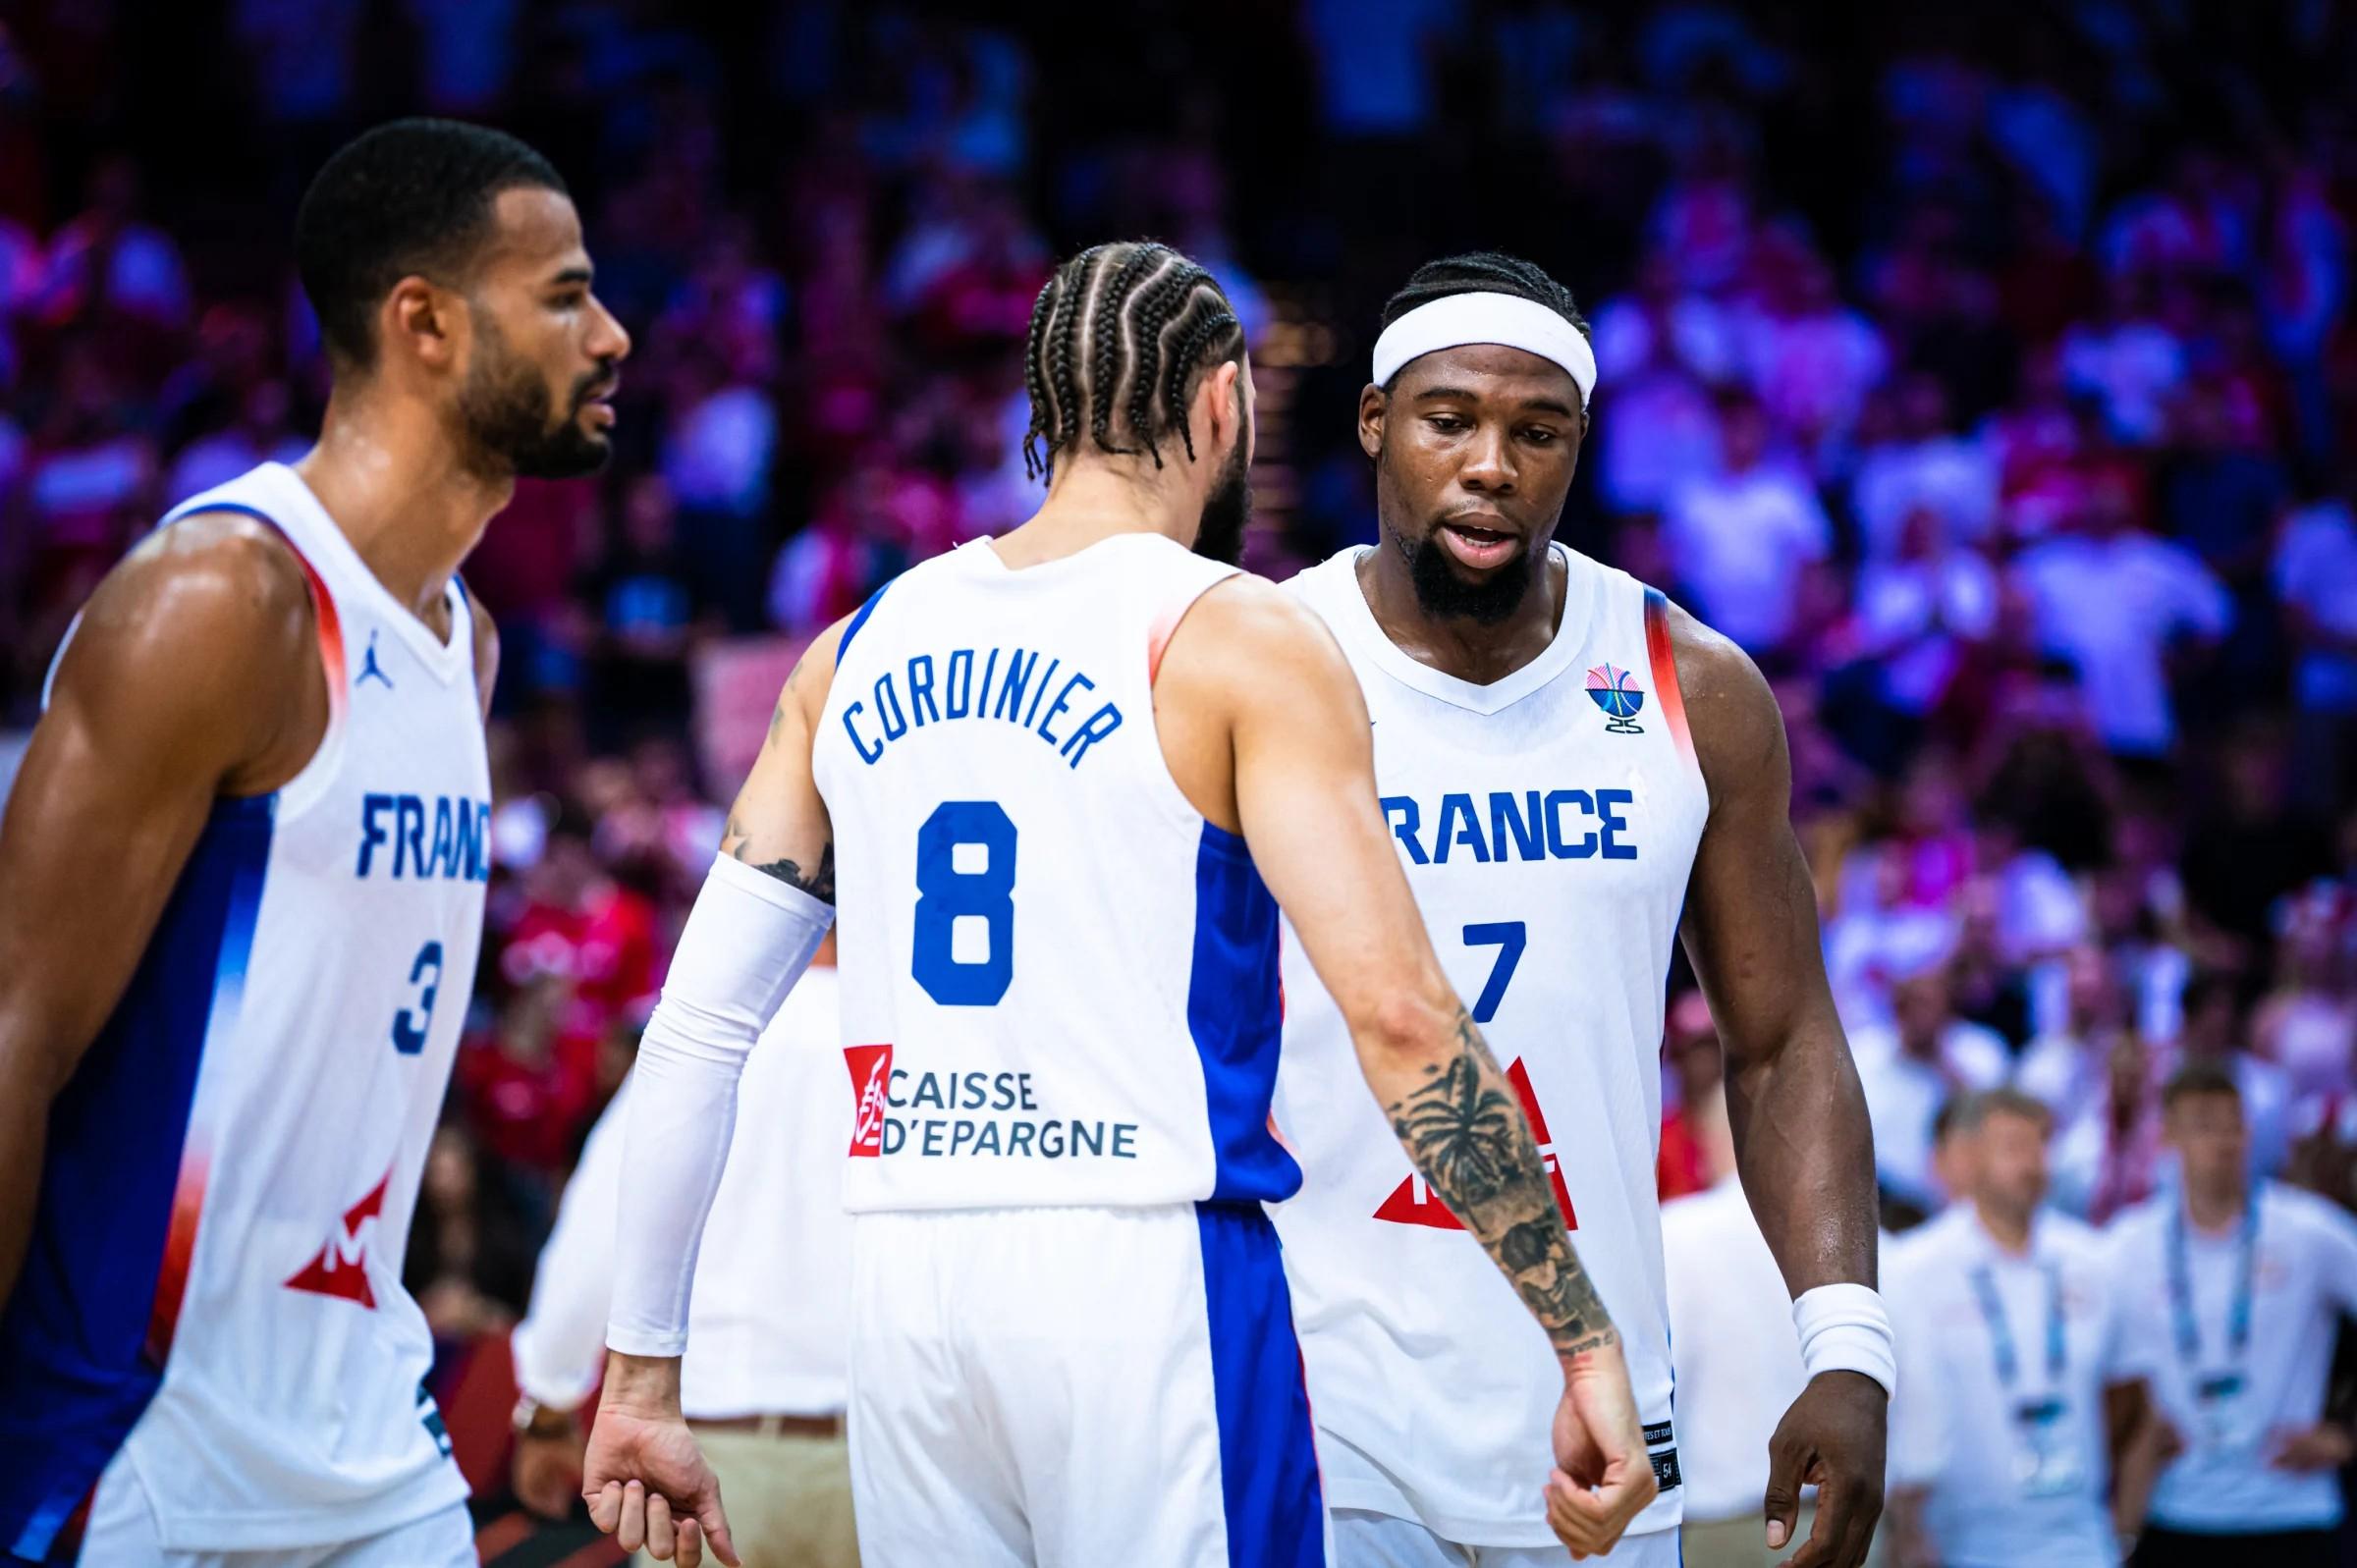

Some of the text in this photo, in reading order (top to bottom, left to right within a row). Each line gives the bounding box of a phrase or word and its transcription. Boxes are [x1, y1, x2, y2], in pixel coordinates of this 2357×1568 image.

[843, 648, 1123, 770] CORDINIER
[356, 793, 491, 882] FRANC
[1379, 788, 1637, 865] RANCE
[911, 801, 1018, 1007] 8
[392, 940, 443, 1054] 3
[1462, 921, 1526, 1023] 7
[887, 1068, 1038, 1111] CAISSE
[882, 1117, 1139, 1159] D'EPARGNE
[1663, 1462, 1672, 1479] 54
